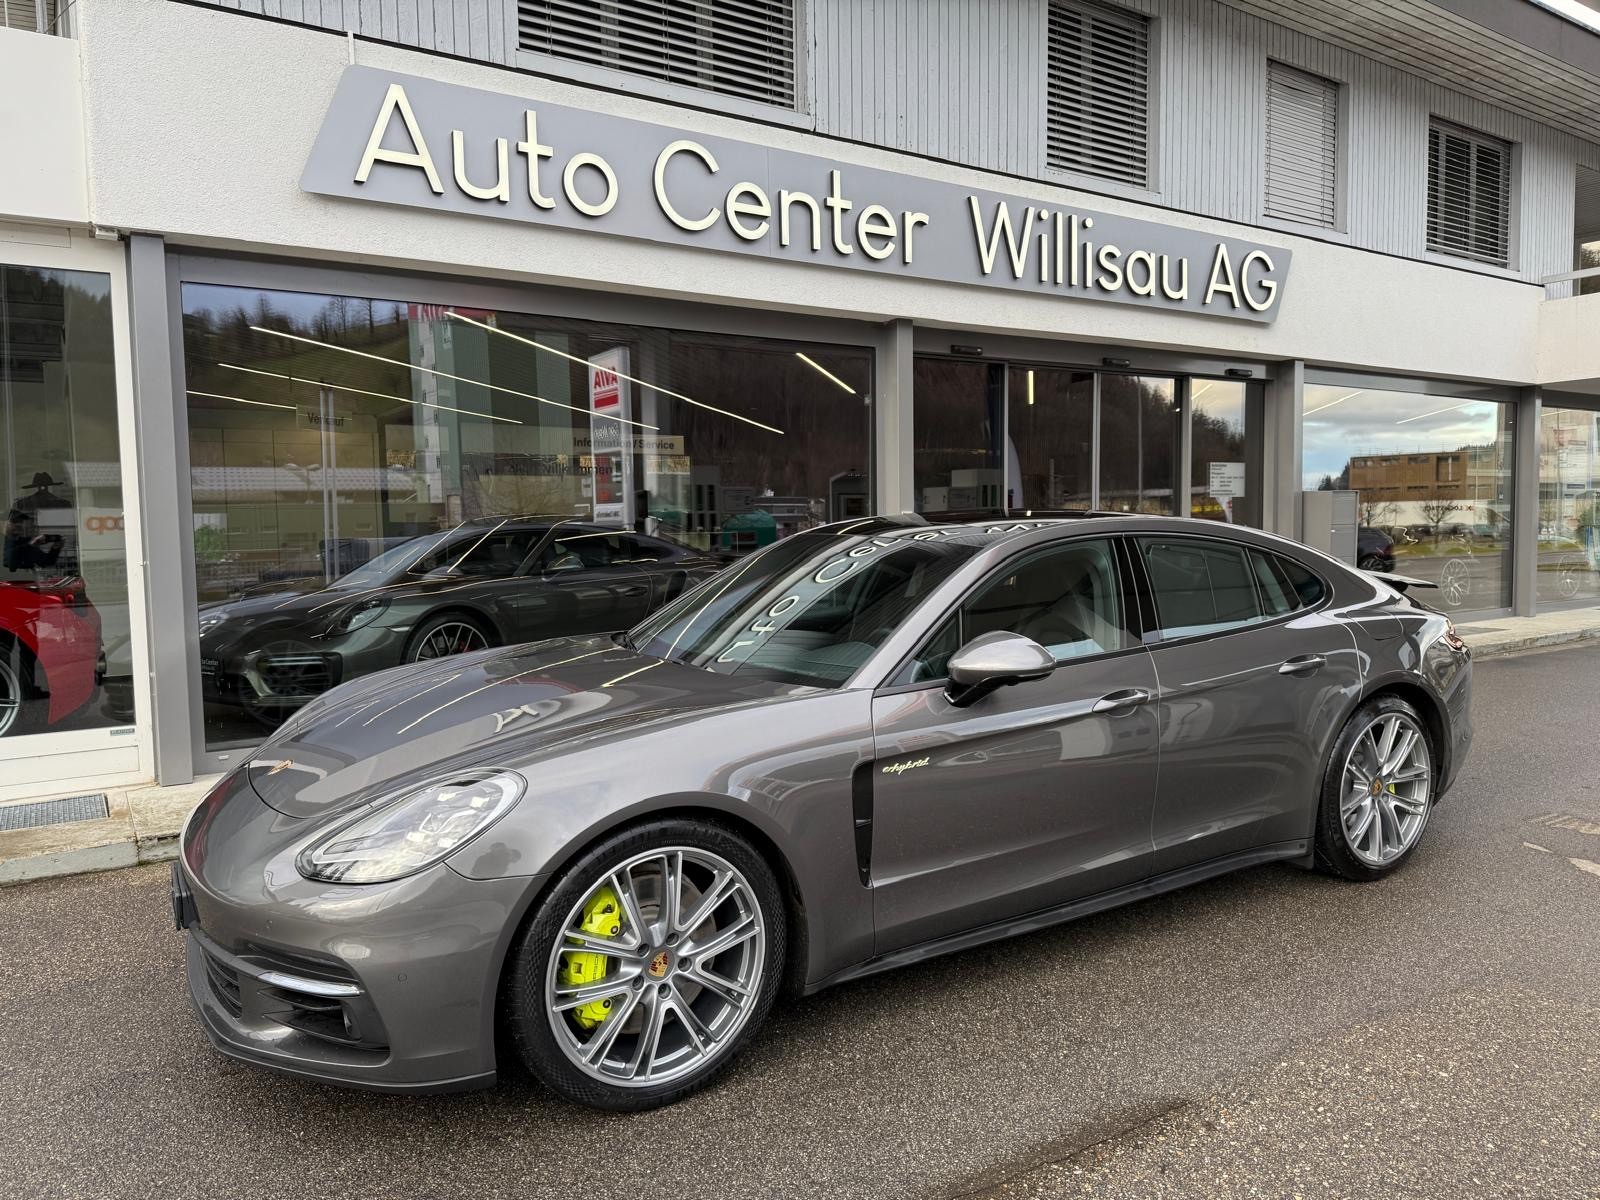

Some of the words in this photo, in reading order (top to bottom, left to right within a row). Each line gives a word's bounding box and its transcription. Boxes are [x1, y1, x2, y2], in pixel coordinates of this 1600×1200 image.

[354, 83, 619, 216] Auto
[653, 139, 929, 264] Center
[968, 195, 1188, 300] Willisau
[1202, 243, 1278, 312] AG
[306, 411, 345, 427] Veruf
